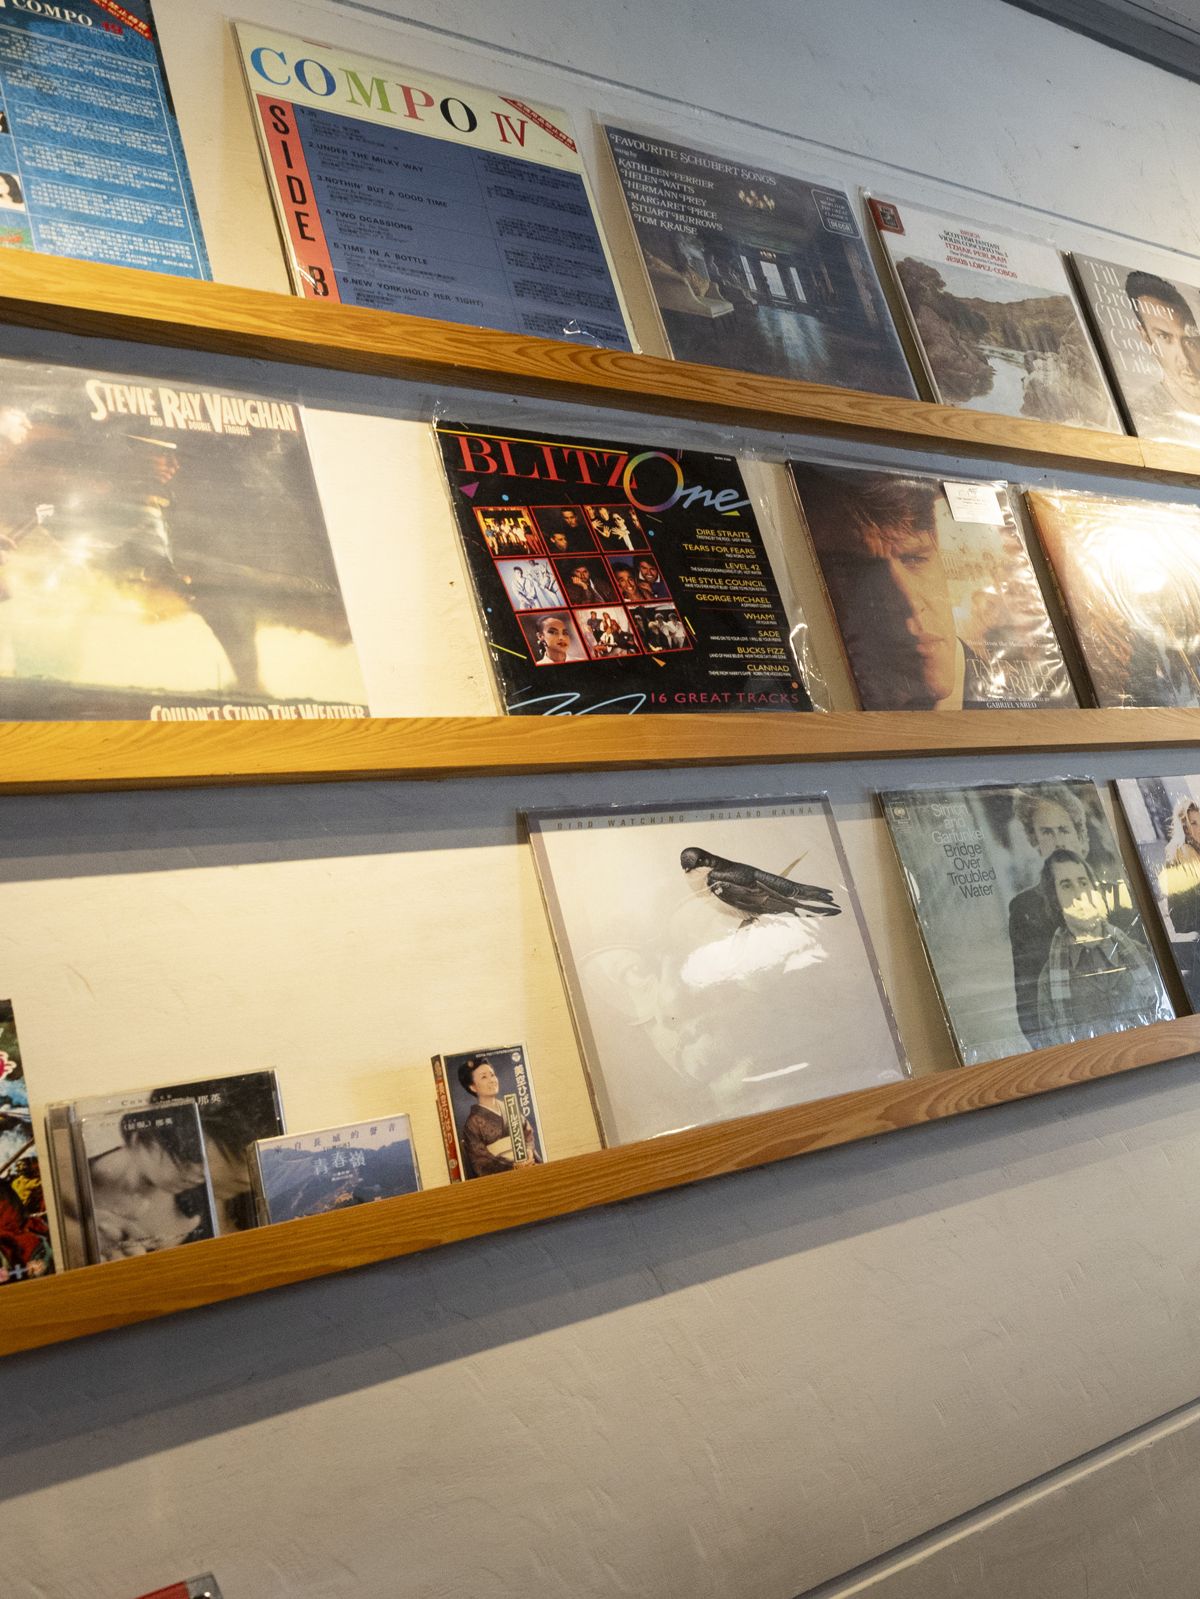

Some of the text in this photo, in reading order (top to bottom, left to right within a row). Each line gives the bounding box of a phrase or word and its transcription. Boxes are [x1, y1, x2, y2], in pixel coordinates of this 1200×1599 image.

[251, 47, 477, 133] COMPO
[490, 111, 528, 147] IV
[403, 163, 424, 173] WAY
[610, 133, 777, 186] FAVOURITE SCHUBERT SONGS
[618, 158, 714, 189] KATHLEEN FERRIER
[620, 168, 695, 194] HELEN WATTS
[269, 104, 316, 242] SIDE
[308, 265, 330, 297] B
[623, 179, 707, 207] HERMANN PREY
[626, 191, 718, 219] MARGARET PRICE
[631, 202, 723, 231] STUART BURROWS
[633, 213, 698, 235] TOM KRAUSE
[1084, 260, 1120, 287] Till
[1094, 283, 1175, 321] Brönner
[1110, 327, 1164, 358] Good
[85, 379, 298, 433] STEVIE RAY VAUGHAN
[150, 417, 251, 436] AND DOUBLE TROUBLE
[454, 434, 752, 513] BLITZ One
[696, 528, 715, 537] DIRE
[716, 530, 750, 539] STRAITS
[683, 543, 755, 555] TEARS FOR FEARS
[725, 562, 748, 571] LEVEL
[699, 577, 723, 586] STYLE
[725, 579, 765, 587] COUNCIL
[695, 593, 771, 604] GEORGE MICHAEL
[744, 612, 775, 621] WHAM!
[758, 630, 780, 638] SADE
[737, 646, 785, 655] BUCKS FIZZ
[747, 664, 790, 672] CLANNAD
[651, 691, 799, 704] 16 GREAT TRACKS
[986, 701, 1015, 709] GABRIEL
[222, 704, 269, 720] STAND
[269, 704, 300, 720] THE
[299, 703, 368, 719] WEATHER
[931, 803, 969, 817] Simon
[557, 807, 813, 831] BIRD WATCHING ROLAND HANNA
[944, 818, 966, 829] and
[931, 827, 985, 844] Garfunkel
[943, 842, 983, 858] Bridge
[953, 857, 981, 871] Over
[947, 866, 997, 886] Troubled
[959, 884, 994, 899] Water
